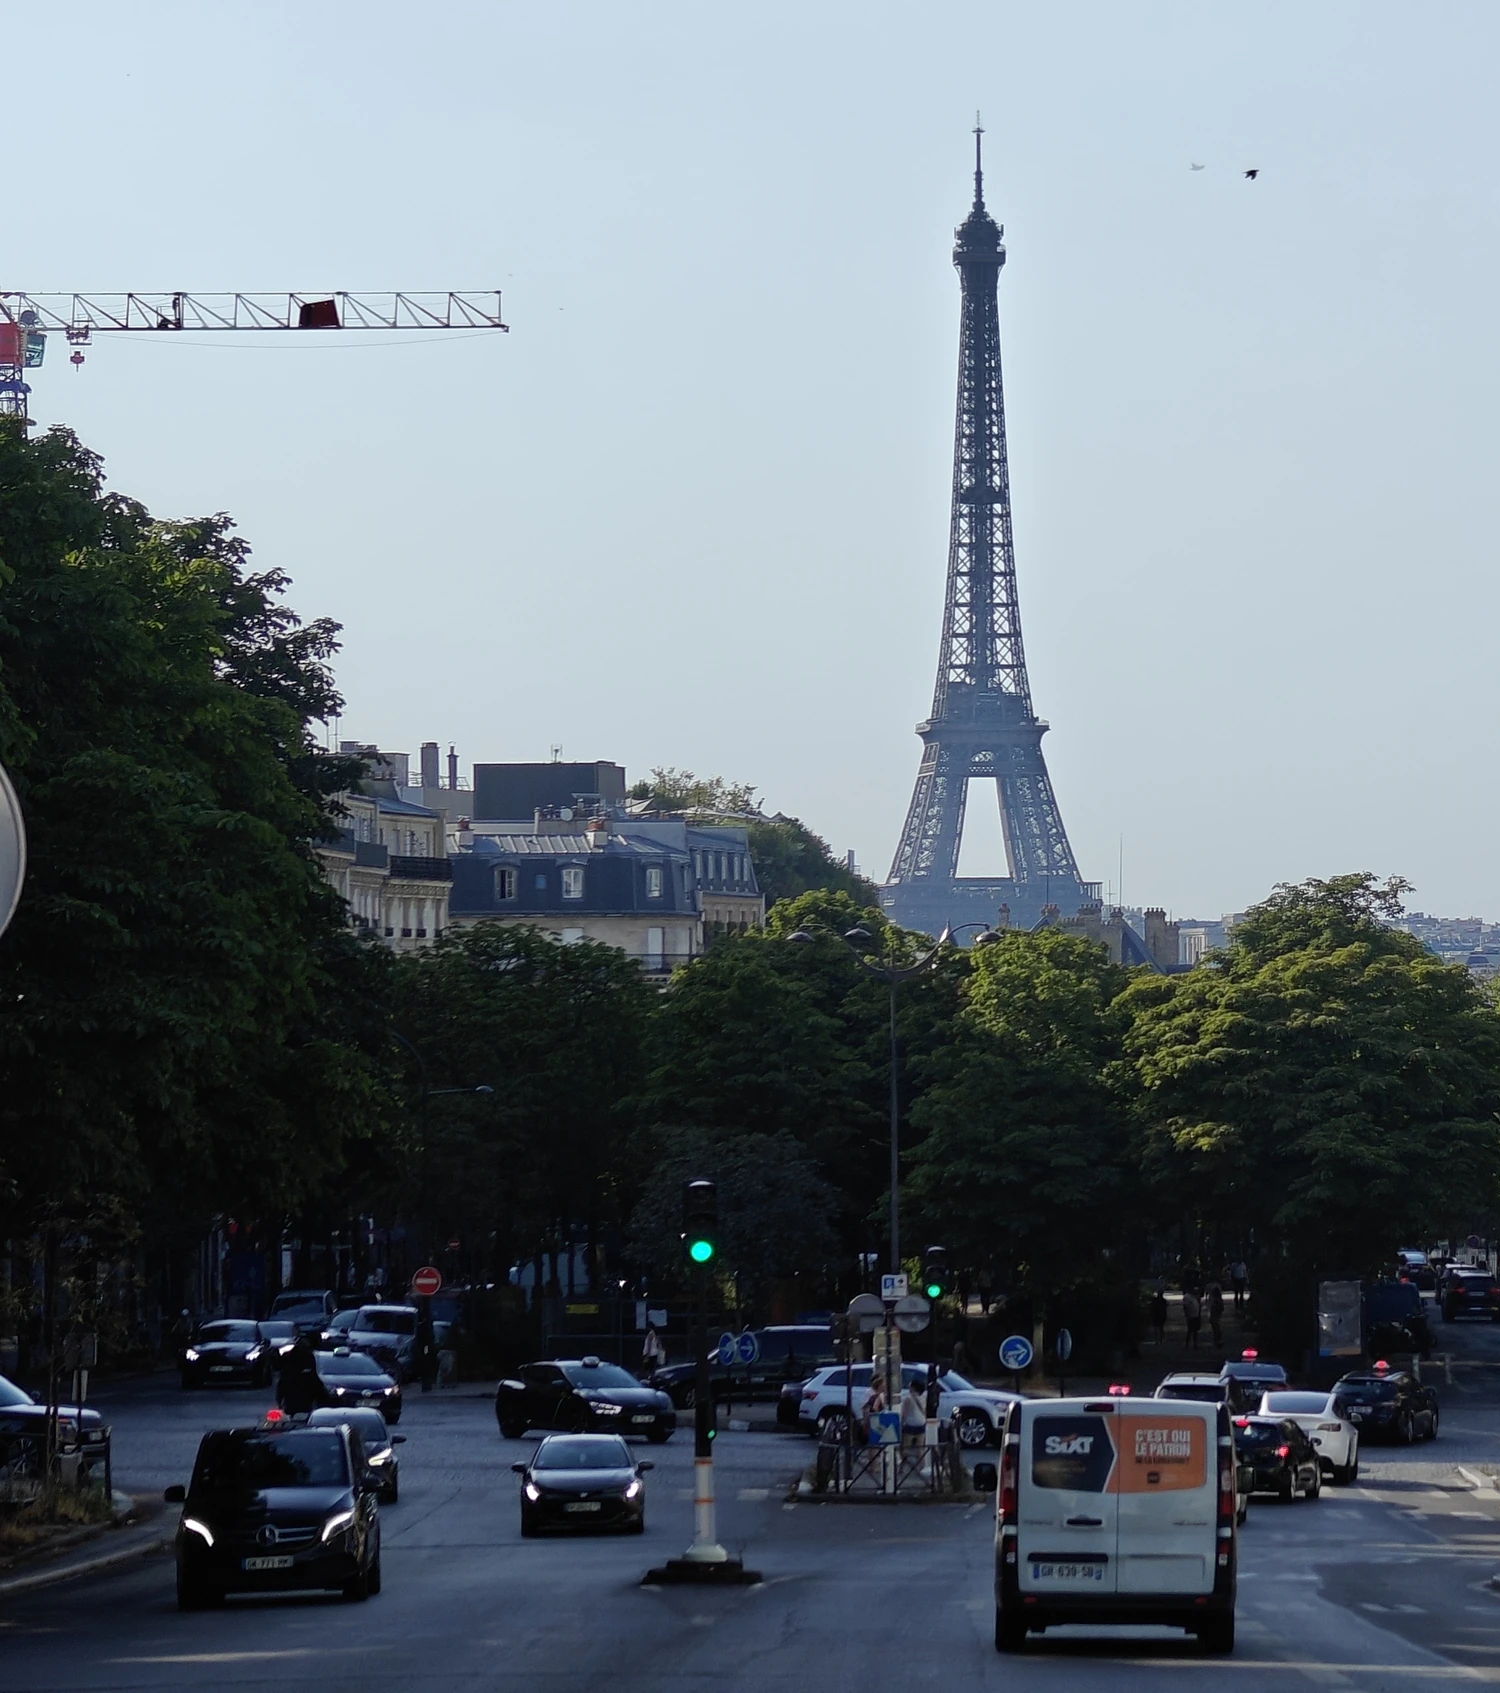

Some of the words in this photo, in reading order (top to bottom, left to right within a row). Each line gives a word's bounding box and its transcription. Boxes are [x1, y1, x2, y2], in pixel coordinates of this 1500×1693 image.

[1136, 1429, 1168, 1442] C'EST
[1045, 1436, 1094, 1454] SIXT
[1135, 1443, 1147, 1456] LE
[1150, 1443, 1190, 1456] PATRON
